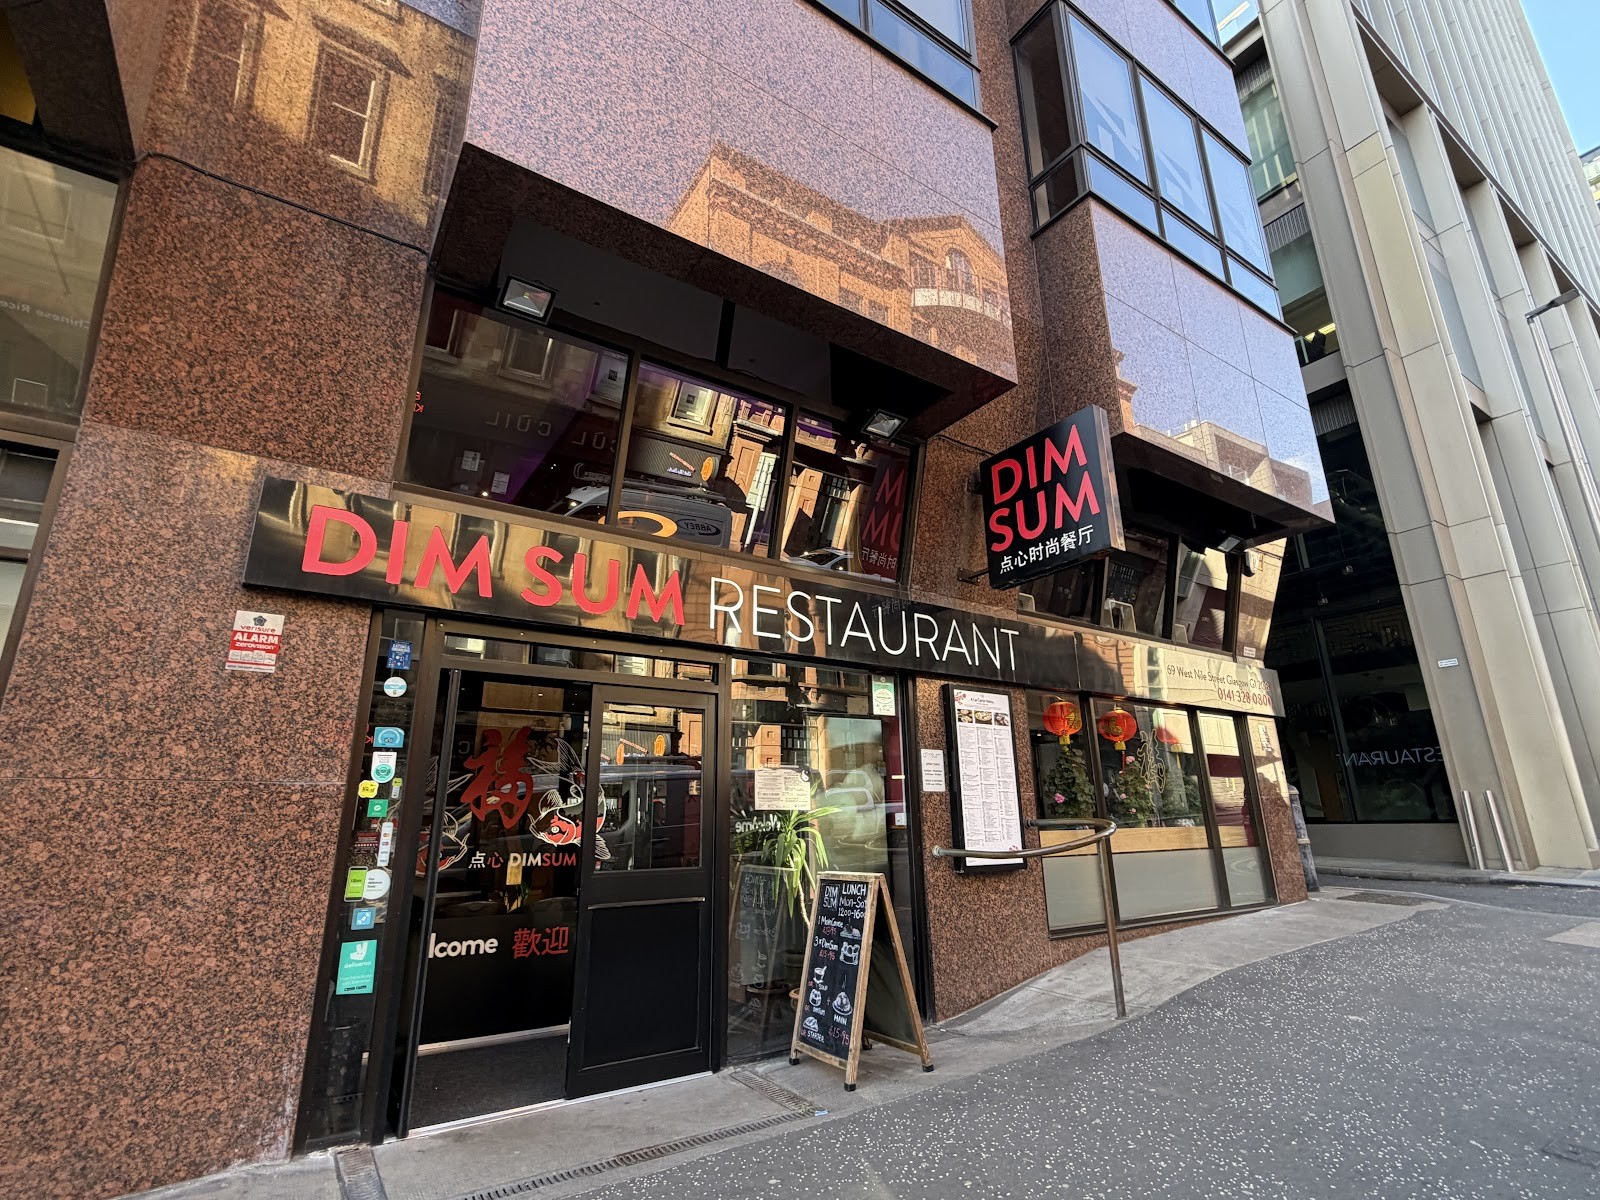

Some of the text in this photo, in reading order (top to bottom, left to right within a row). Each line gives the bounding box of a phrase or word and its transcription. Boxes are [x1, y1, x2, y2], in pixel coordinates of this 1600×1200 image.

[991, 424, 1088, 505] DIM
[988, 470, 1101, 552] SUM
[999, 524, 1094, 574] 点心时尚餐厅
[302, 504, 1020, 671] DIM SUM RESTAURANT
[233, 632, 279, 644] ALARM
[240, 625, 276, 633] verisure
[1166, 664, 1176, 675] 69
[1176, 665, 1194, 679] West
[1193, 668, 1207, 681] Nile
[1207, 672, 1226, 684] Street
[1226, 674, 1249, 690] Glasgow
[1217, 687, 1235, 701] 0141
[1235, 691, 1250, 704] 328
[460, 726, 534, 828] 福
[468, 851, 577, 869] 点心 DIMSUM
[825, 886, 839, 898] DIM
[842, 883, 866, 896] LUNCH
